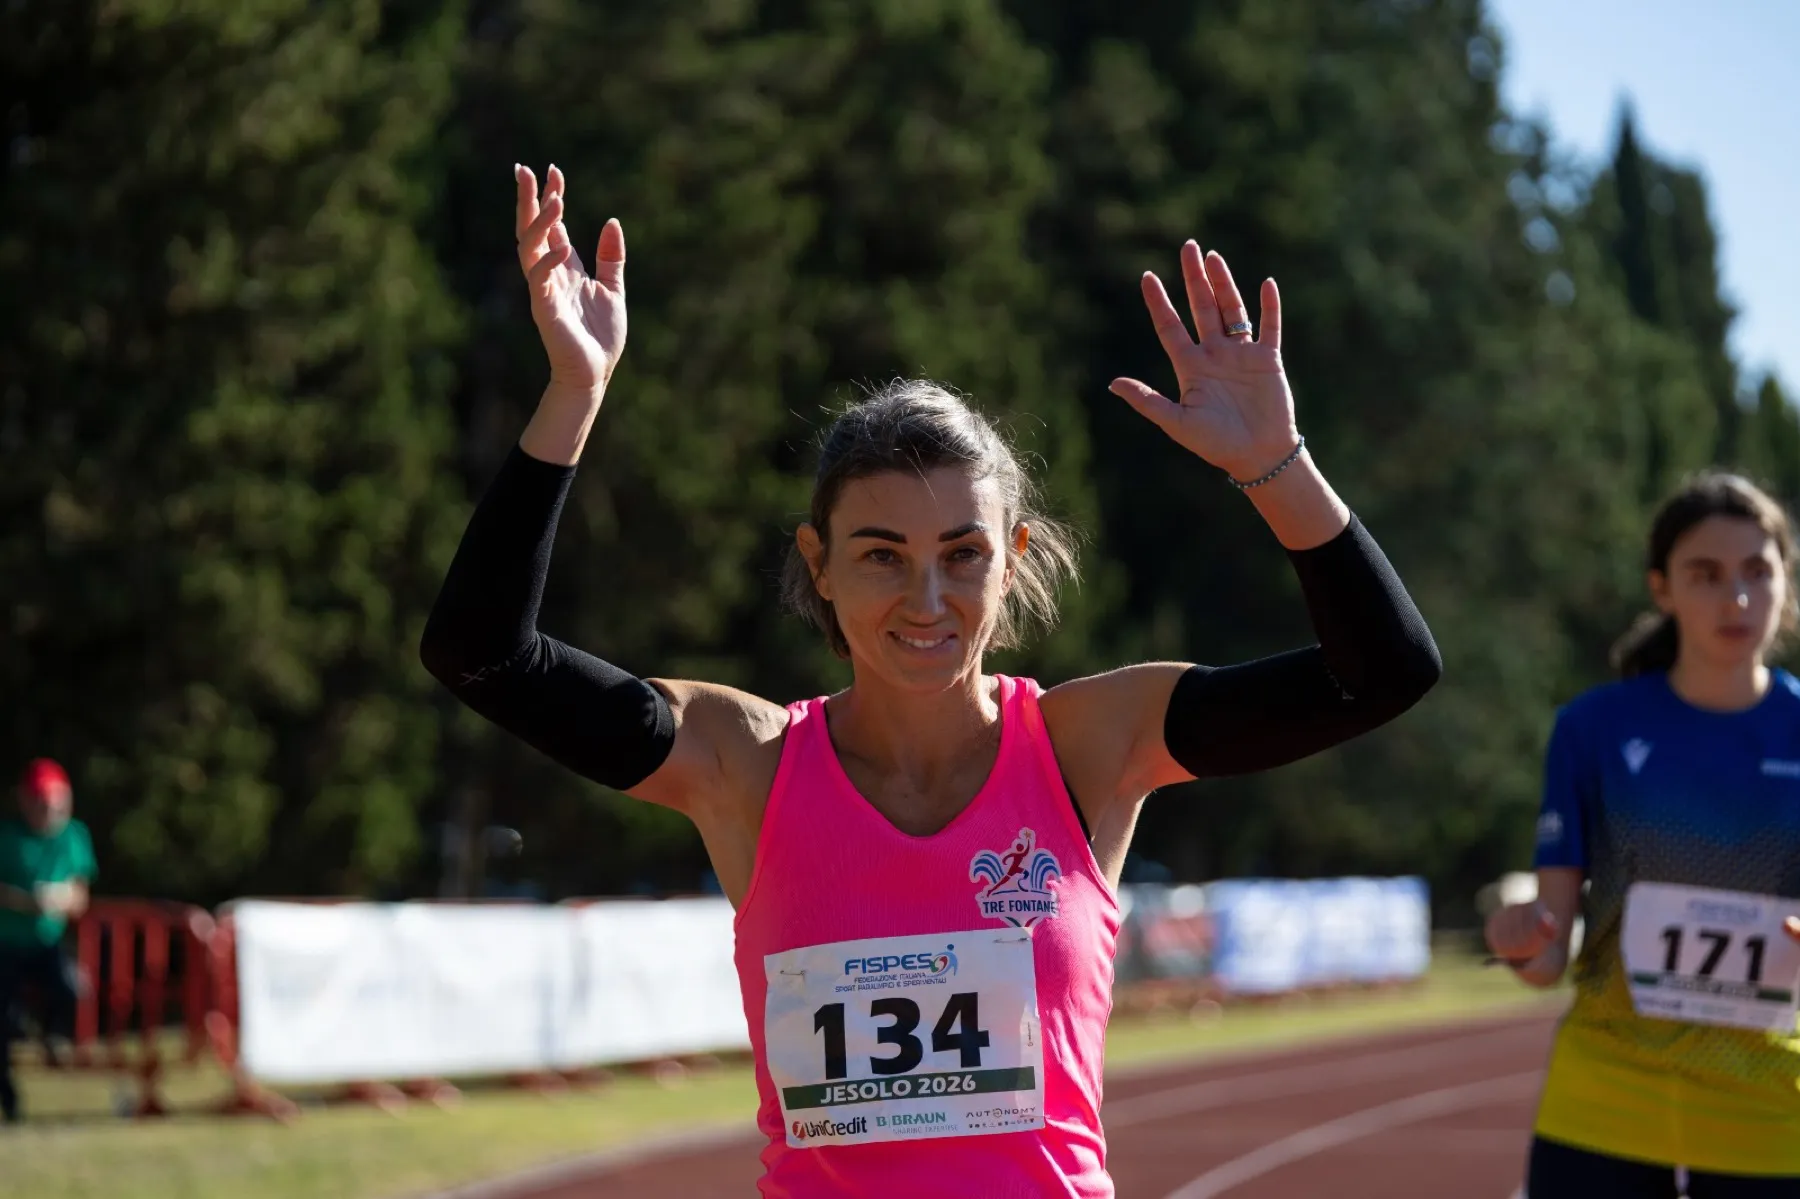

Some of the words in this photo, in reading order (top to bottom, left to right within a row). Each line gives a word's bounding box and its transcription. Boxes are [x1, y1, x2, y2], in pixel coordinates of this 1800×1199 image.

[983, 900, 1005, 913] TRE
[1661, 925, 1767, 983] 171
[844, 952, 933, 975] FISPES
[854, 974, 898, 984] FEDERAZIONE
[900, 972, 926, 981] ITALIANA
[835, 984, 856, 993] SPORT
[814, 992, 990, 1080] 134
[820, 1079, 912, 1104] JESOLO
[917, 1074, 977, 1095] 2026
[892, 1111, 946, 1126] BRAUN
[965, 1106, 1036, 1119] AUTONOMY
[805, 1116, 868, 1138] UniCredit
